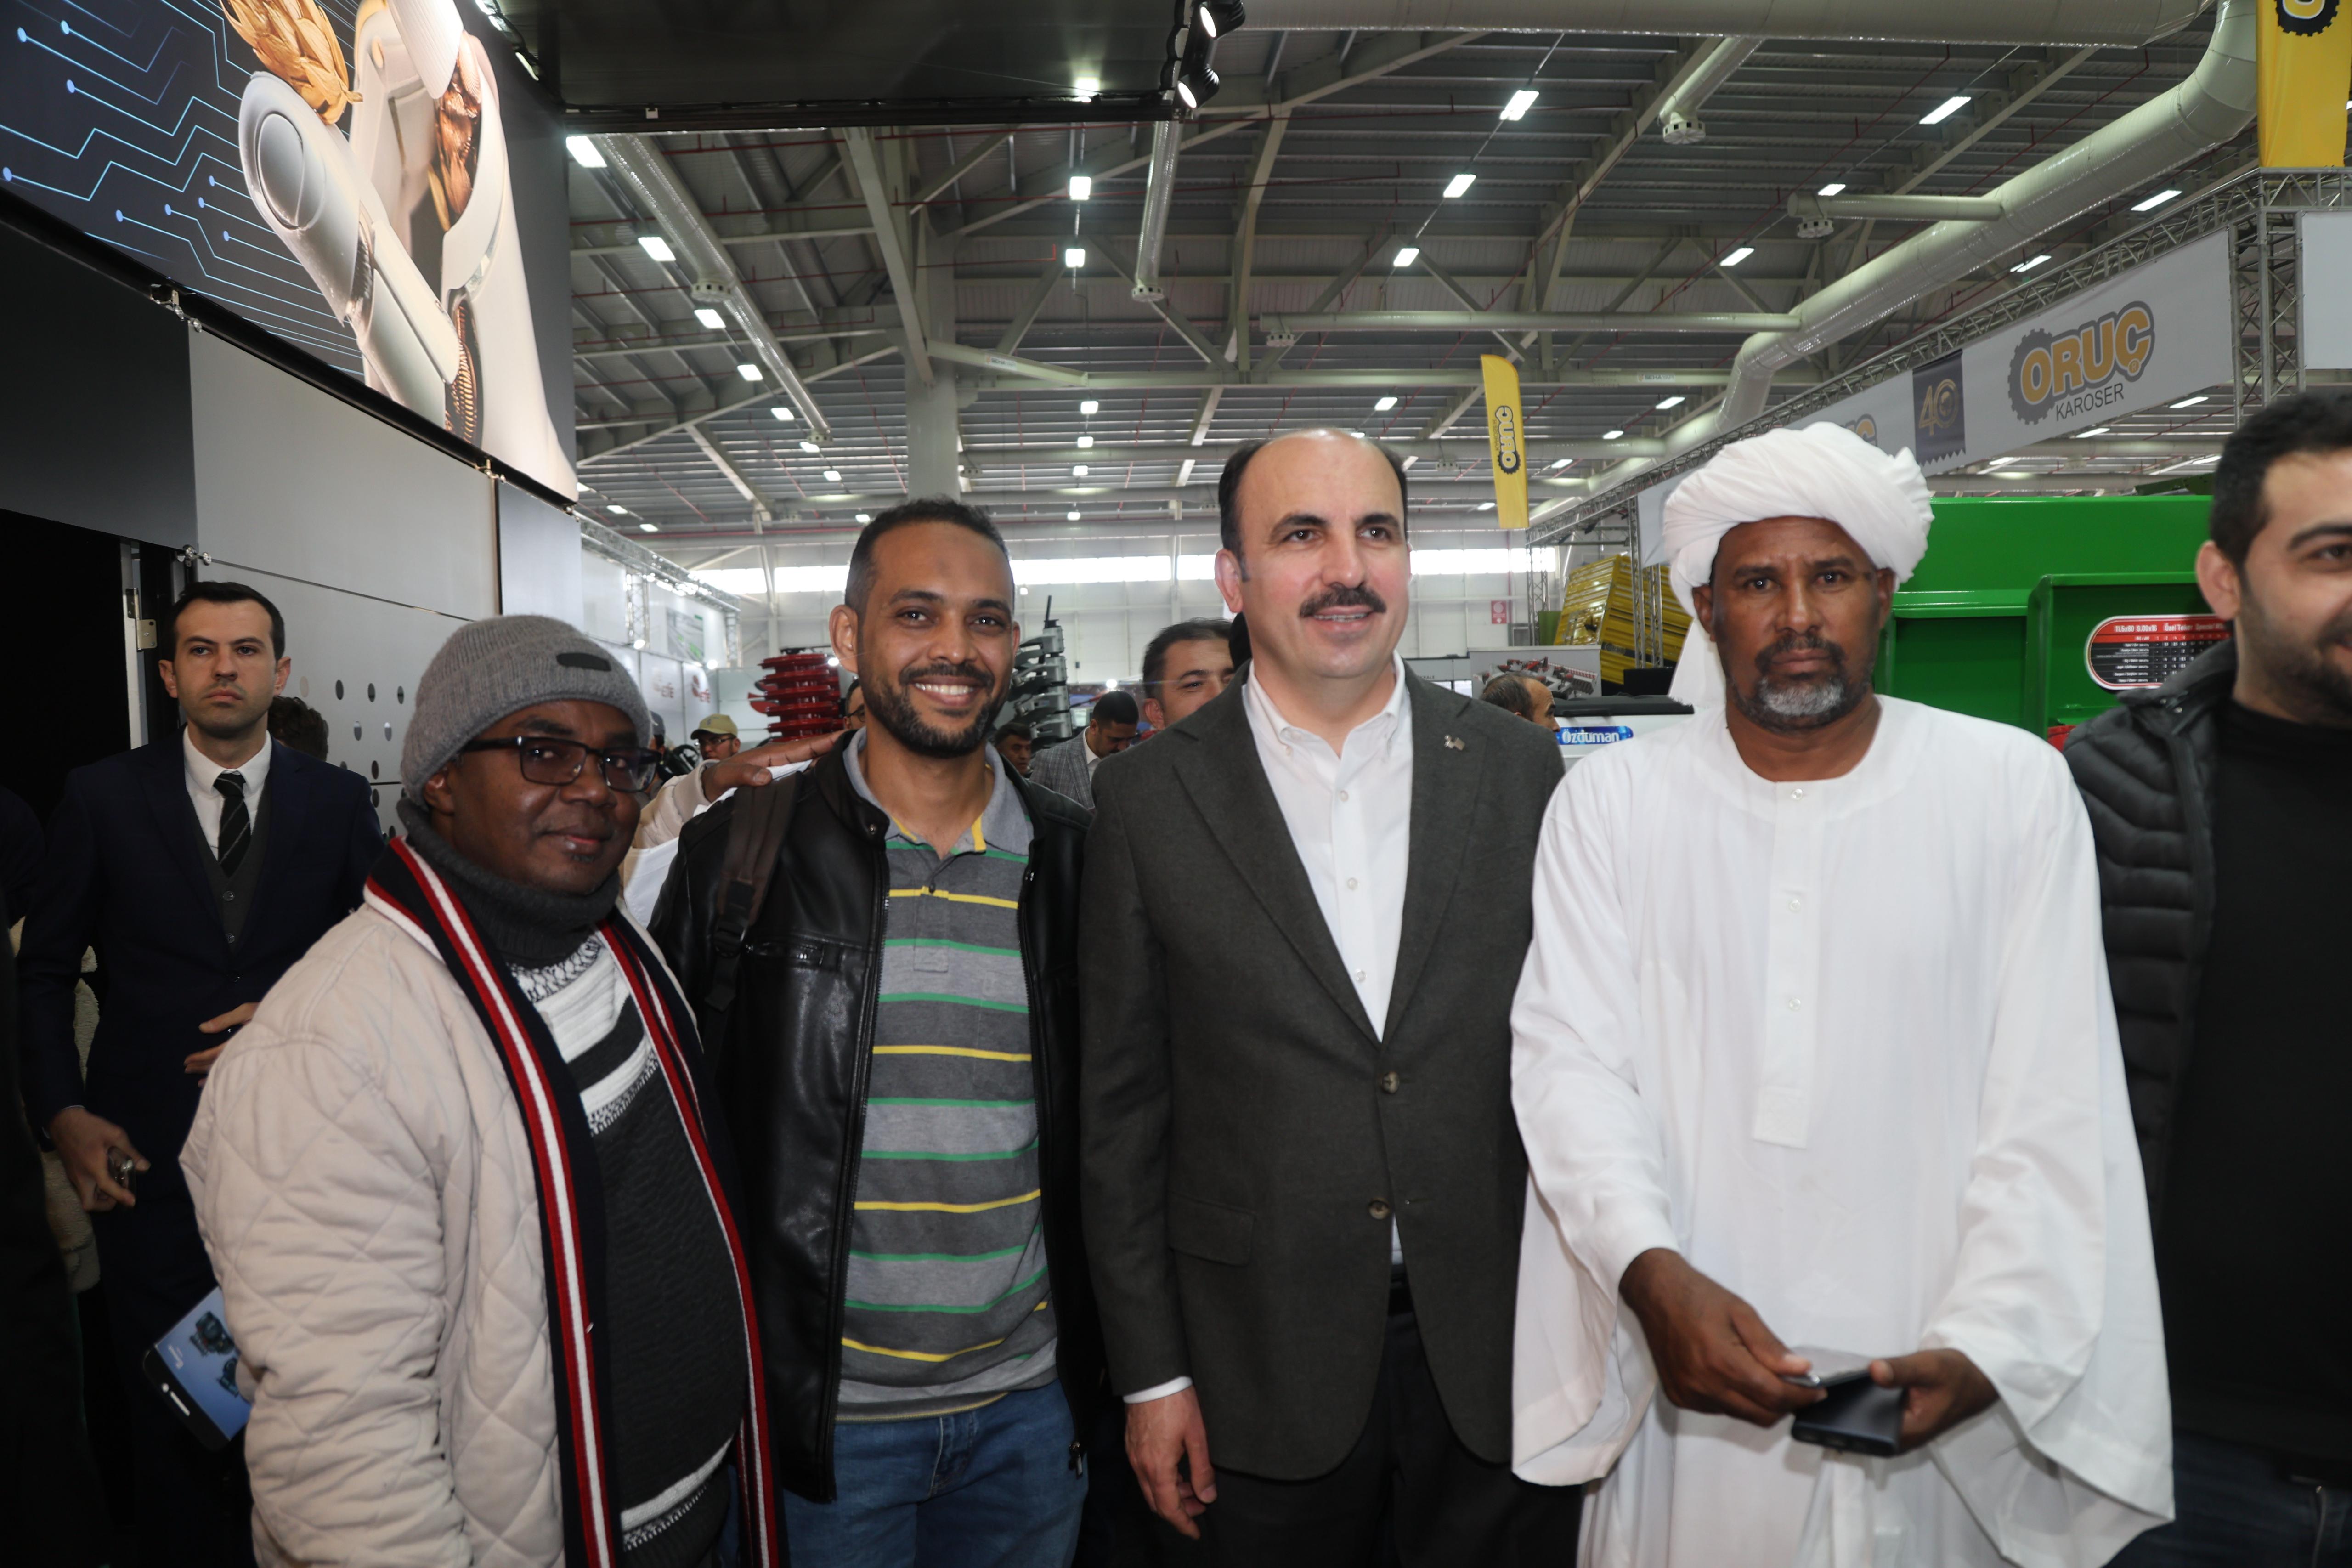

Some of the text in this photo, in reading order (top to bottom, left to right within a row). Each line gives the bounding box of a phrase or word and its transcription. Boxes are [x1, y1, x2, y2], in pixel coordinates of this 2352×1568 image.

[2021, 306, 2151, 405] ORUÇ
[2056, 382, 2125, 422] KAROSER
[1562, 729, 1620, 743] Özduman
